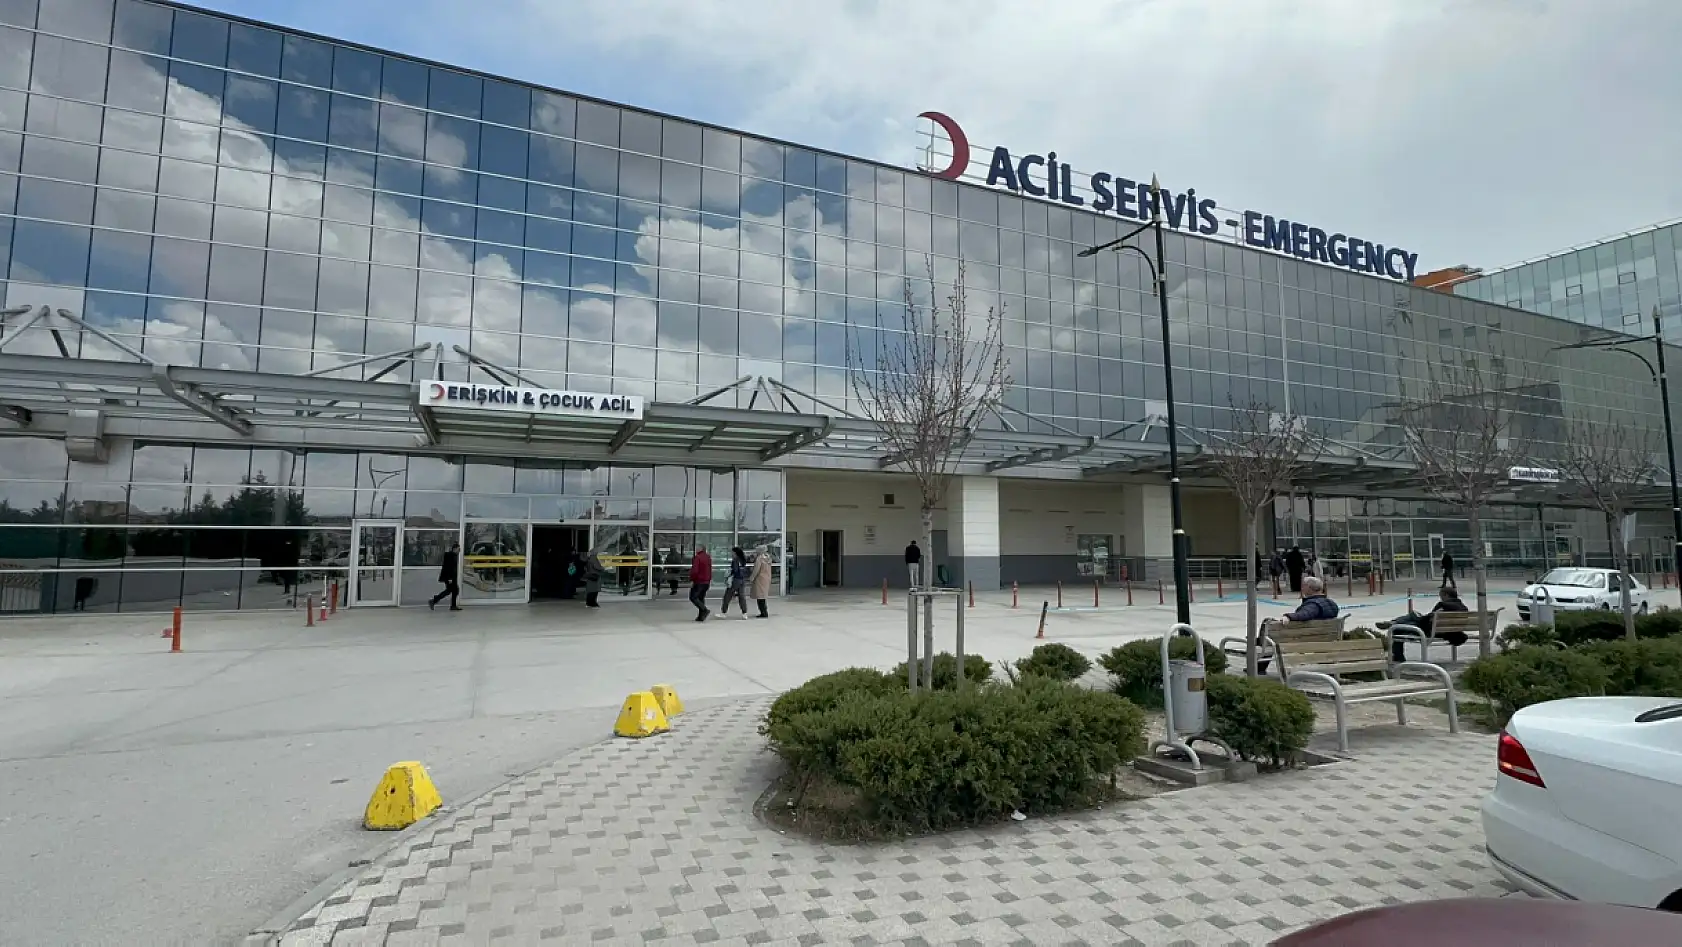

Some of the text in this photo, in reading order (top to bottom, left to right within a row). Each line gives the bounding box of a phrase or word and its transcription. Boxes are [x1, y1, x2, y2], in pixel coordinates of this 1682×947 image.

[986, 146, 1084, 205] ACİL
[1091, 172, 1218, 235] SERVİS
[1245, 210, 1419, 281] EMERGENCY
[447, 385, 635, 412] ERİŞKİN & ÇOCUK ACİL
